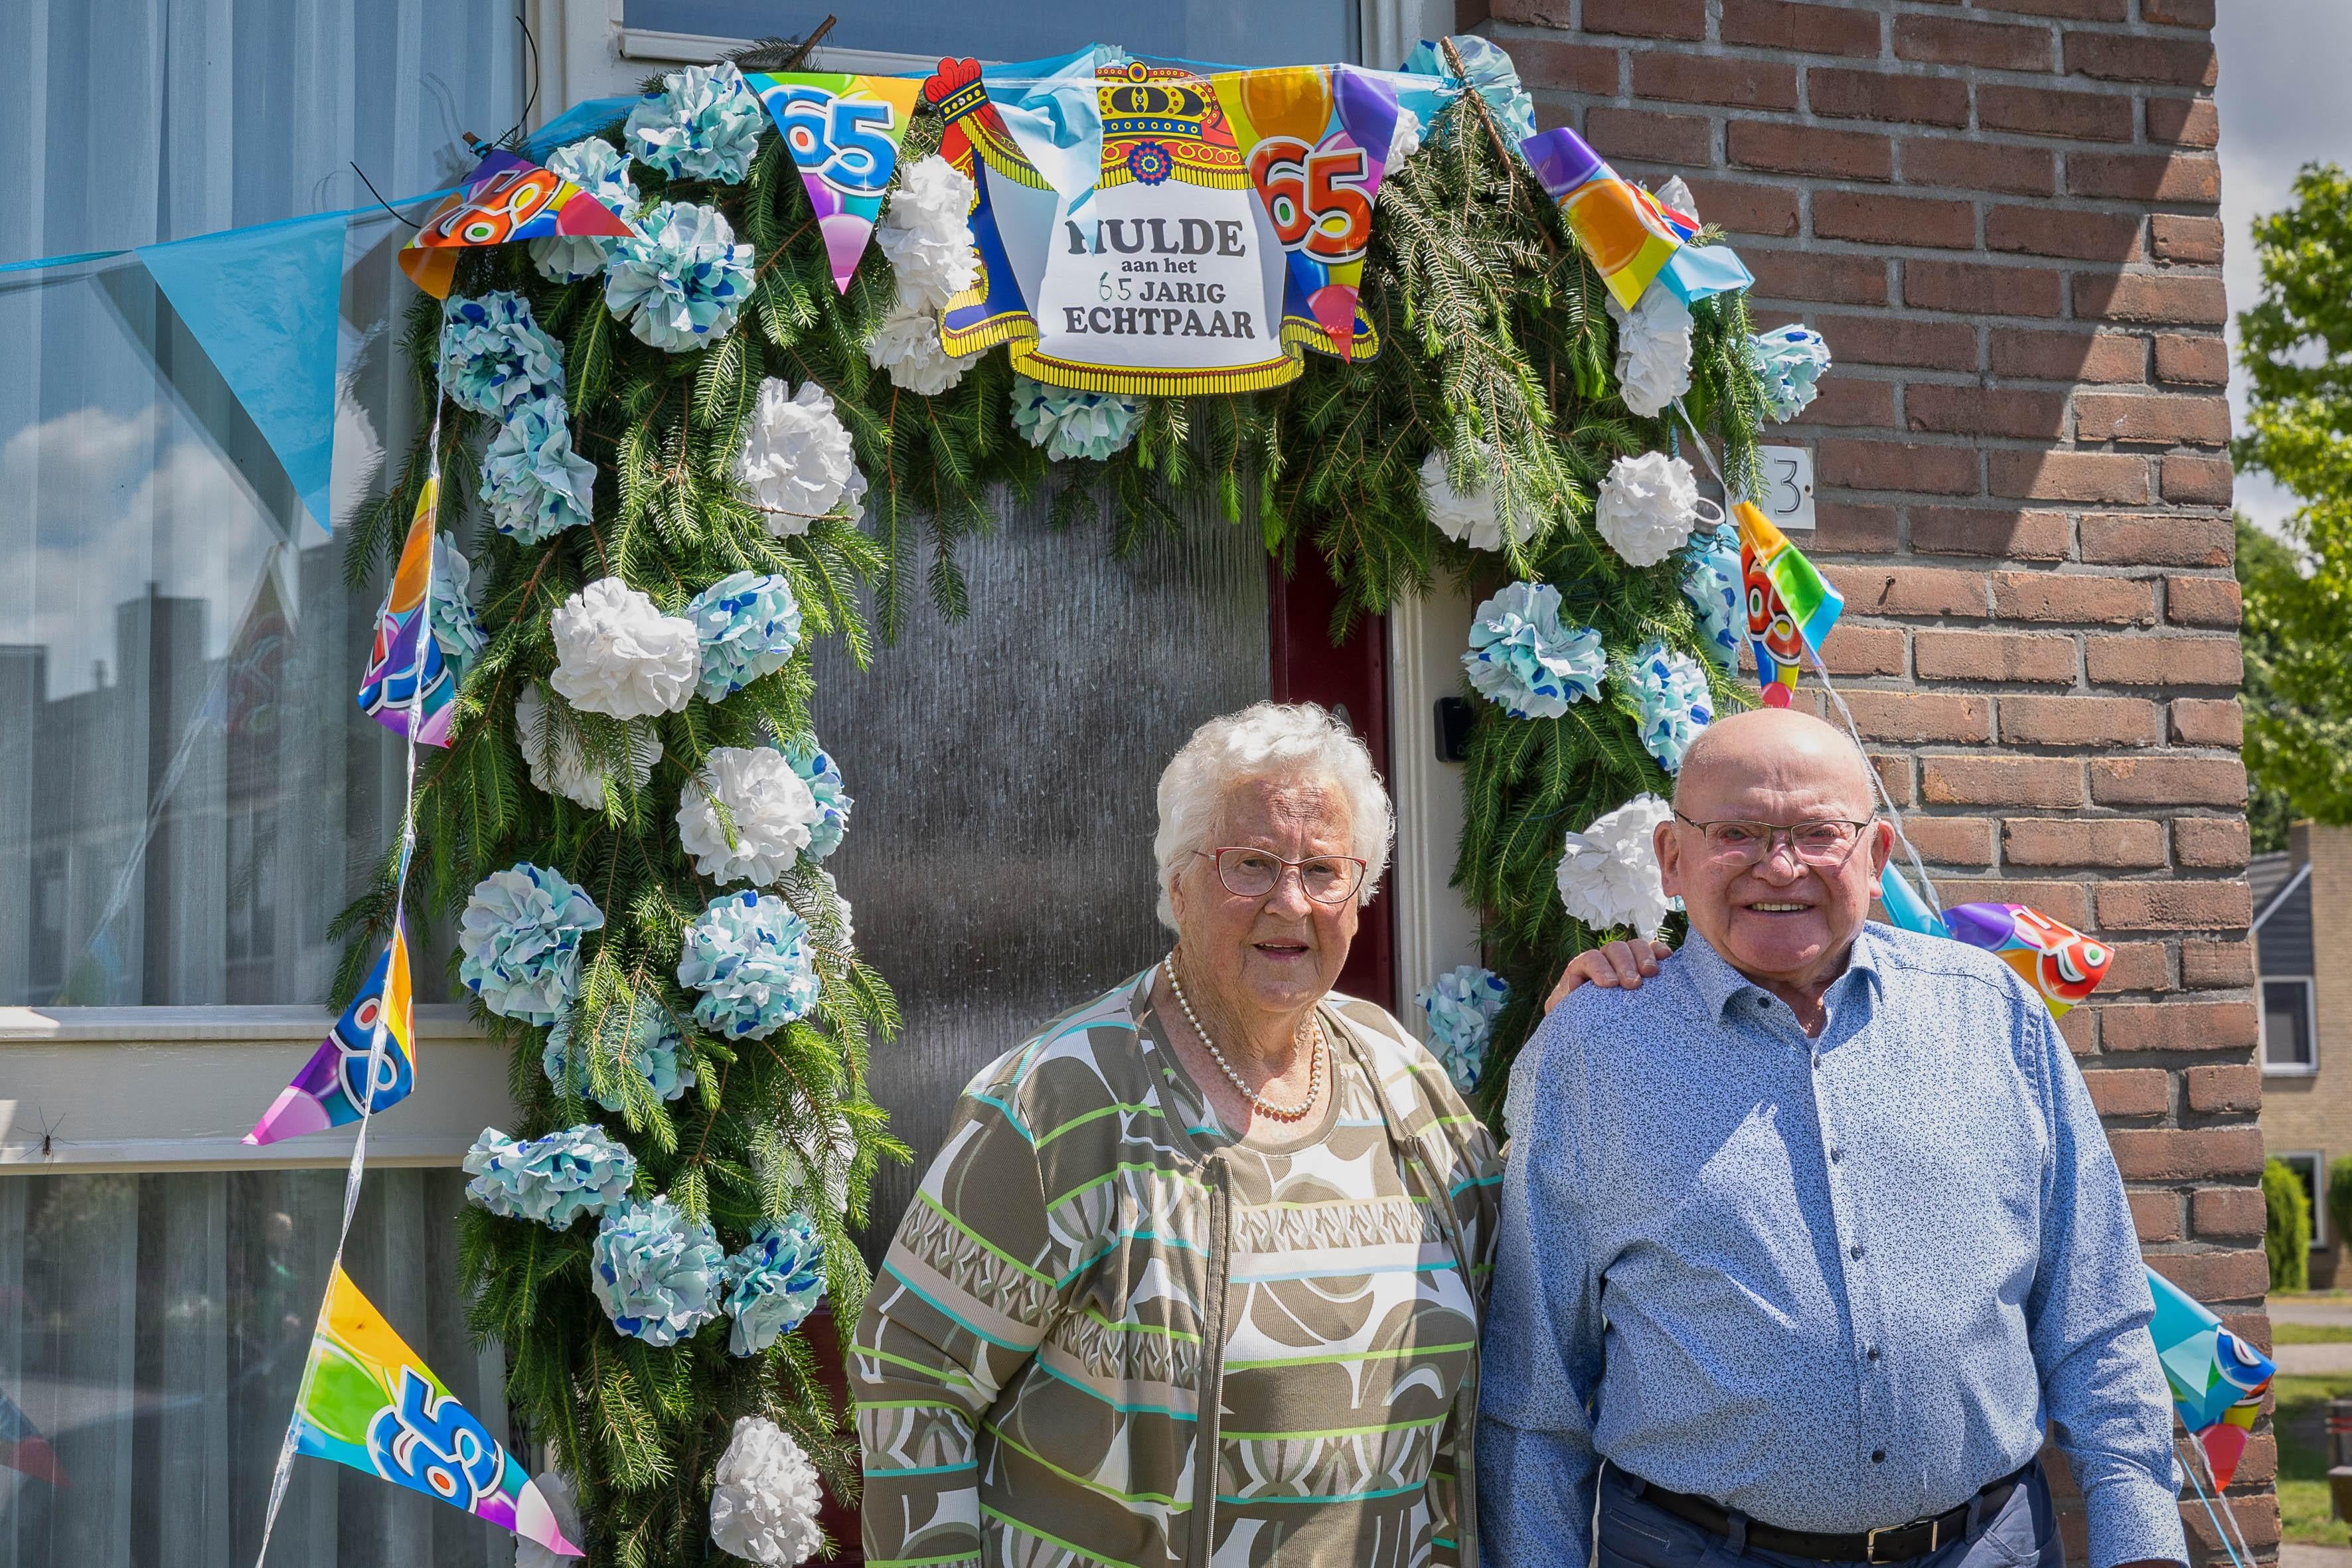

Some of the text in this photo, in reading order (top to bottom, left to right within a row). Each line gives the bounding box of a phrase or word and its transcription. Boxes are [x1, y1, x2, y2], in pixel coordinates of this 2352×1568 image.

[759, 84, 901, 197] 65
[1245, 135, 1376, 264] 65
[1099, 271, 1226, 303] 65 JARIG
[1121, 258, 1197, 274] aan het
[1062, 306, 1255, 339] ECHTPAAR
[366, 1364, 505, 1514] 65
